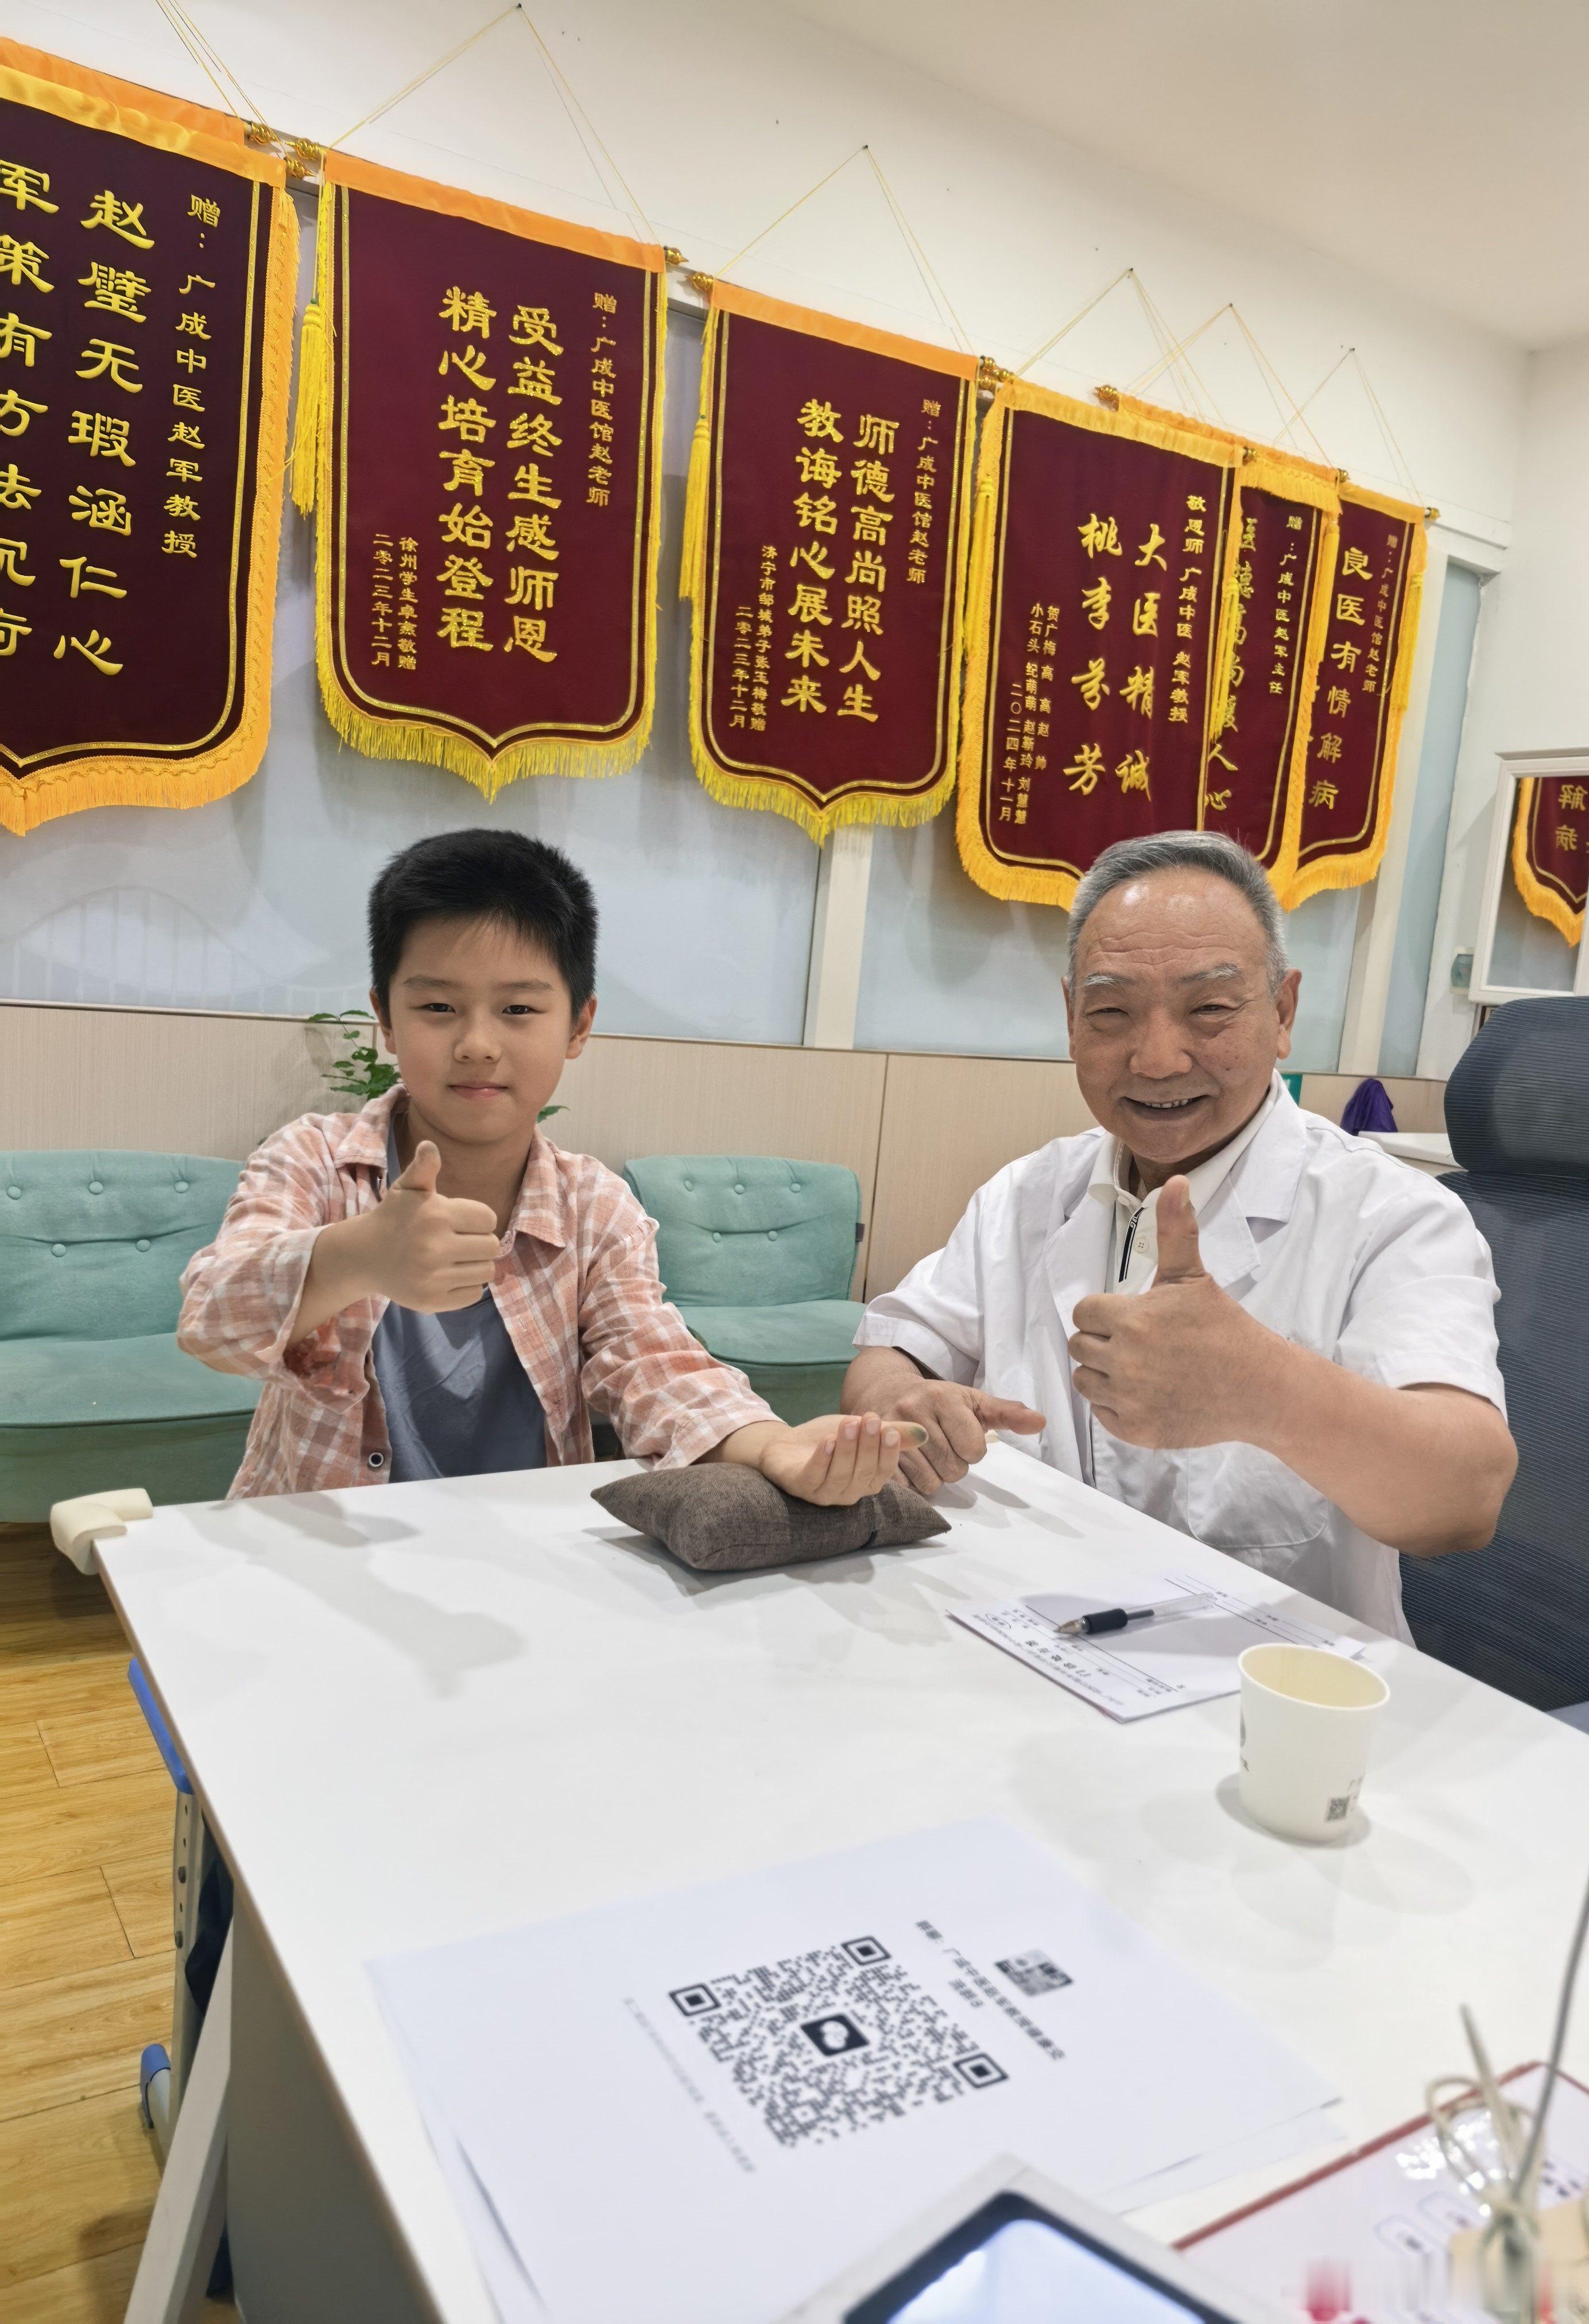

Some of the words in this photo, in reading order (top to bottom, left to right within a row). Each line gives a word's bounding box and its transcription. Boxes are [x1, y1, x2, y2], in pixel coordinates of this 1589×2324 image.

[53, 189, 155, 675] 赵璧无瑕涵仁心
[161, 194, 221, 558] 赠：广成中医赵军教授
[436, 286, 497, 652] 精心培育始登程
[503, 305, 564, 663] 受益终生感师恩
[586, 292, 617, 507] 赠：广成中医馆赵老师
[906, 398, 941, 584] 赠：广成中医馆赵老师
[371, 533, 394, 667] 二零二三年十二月
[728, 606, 754, 728] 二零二三年十二月
[781, 398, 844, 713] 教诲铭心展未来
[836, 414, 900, 722] 师德高尚照人生
[1026, 603, 1044, 653] 小石头
[1063, 513, 1123, 795] 桃李芬芳
[1115, 523, 1167, 801] 大医精诚
[1168, 651, 1191, 723] 赵军教授
[1176, 567, 1203, 640] 广成中医
[1308, 547, 1373, 809] 良医有情解病
